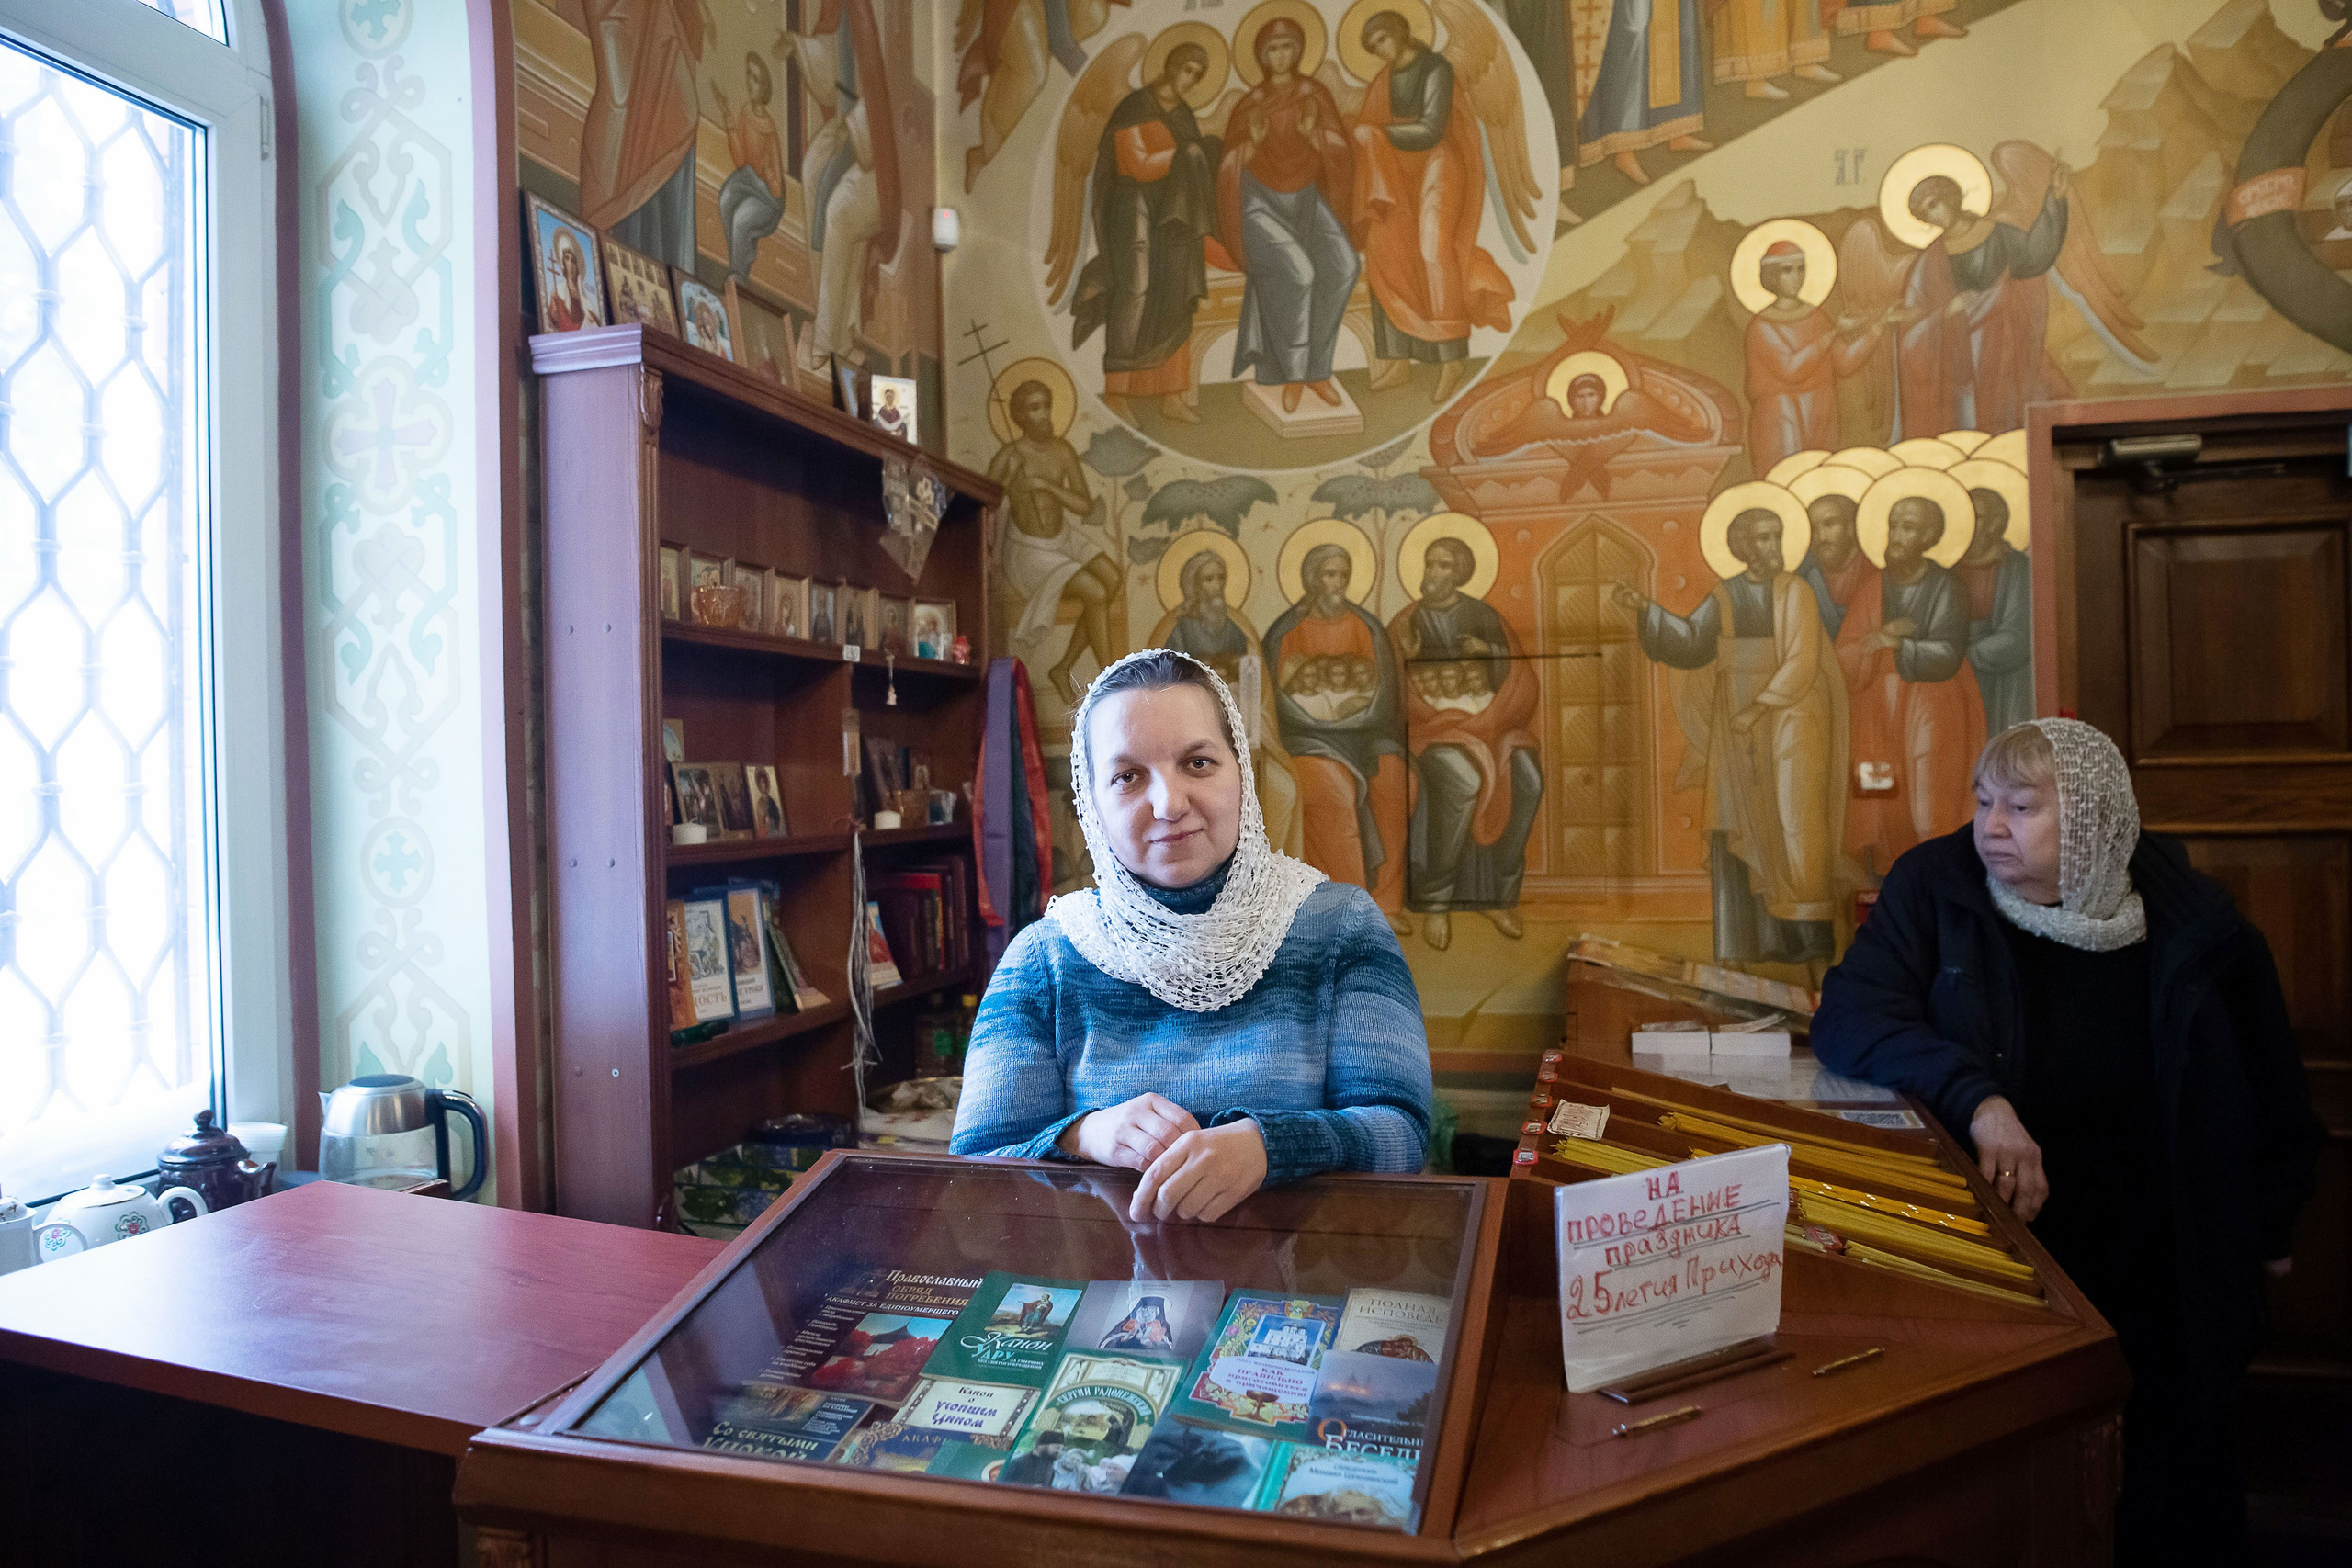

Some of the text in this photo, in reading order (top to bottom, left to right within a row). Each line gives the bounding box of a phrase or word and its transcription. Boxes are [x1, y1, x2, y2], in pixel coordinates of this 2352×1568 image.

[1645, 1171, 1682, 1200] НА
[885, 1269, 984, 1288] Православный
[892, 1285, 933, 1295] ОБРЯД
[826, 1296, 866, 1307] АКАФИСТ
[879, 1303, 959, 1316] ЕДИНОУМЕРШЕГО
[885, 1292, 970, 1306] ПОГРЕБЕНИЯ
[1261, 1368, 1283, 1376] КАК
[958, 1386, 995, 1398] Канон
[712, 1421, 733, 1436] Со
